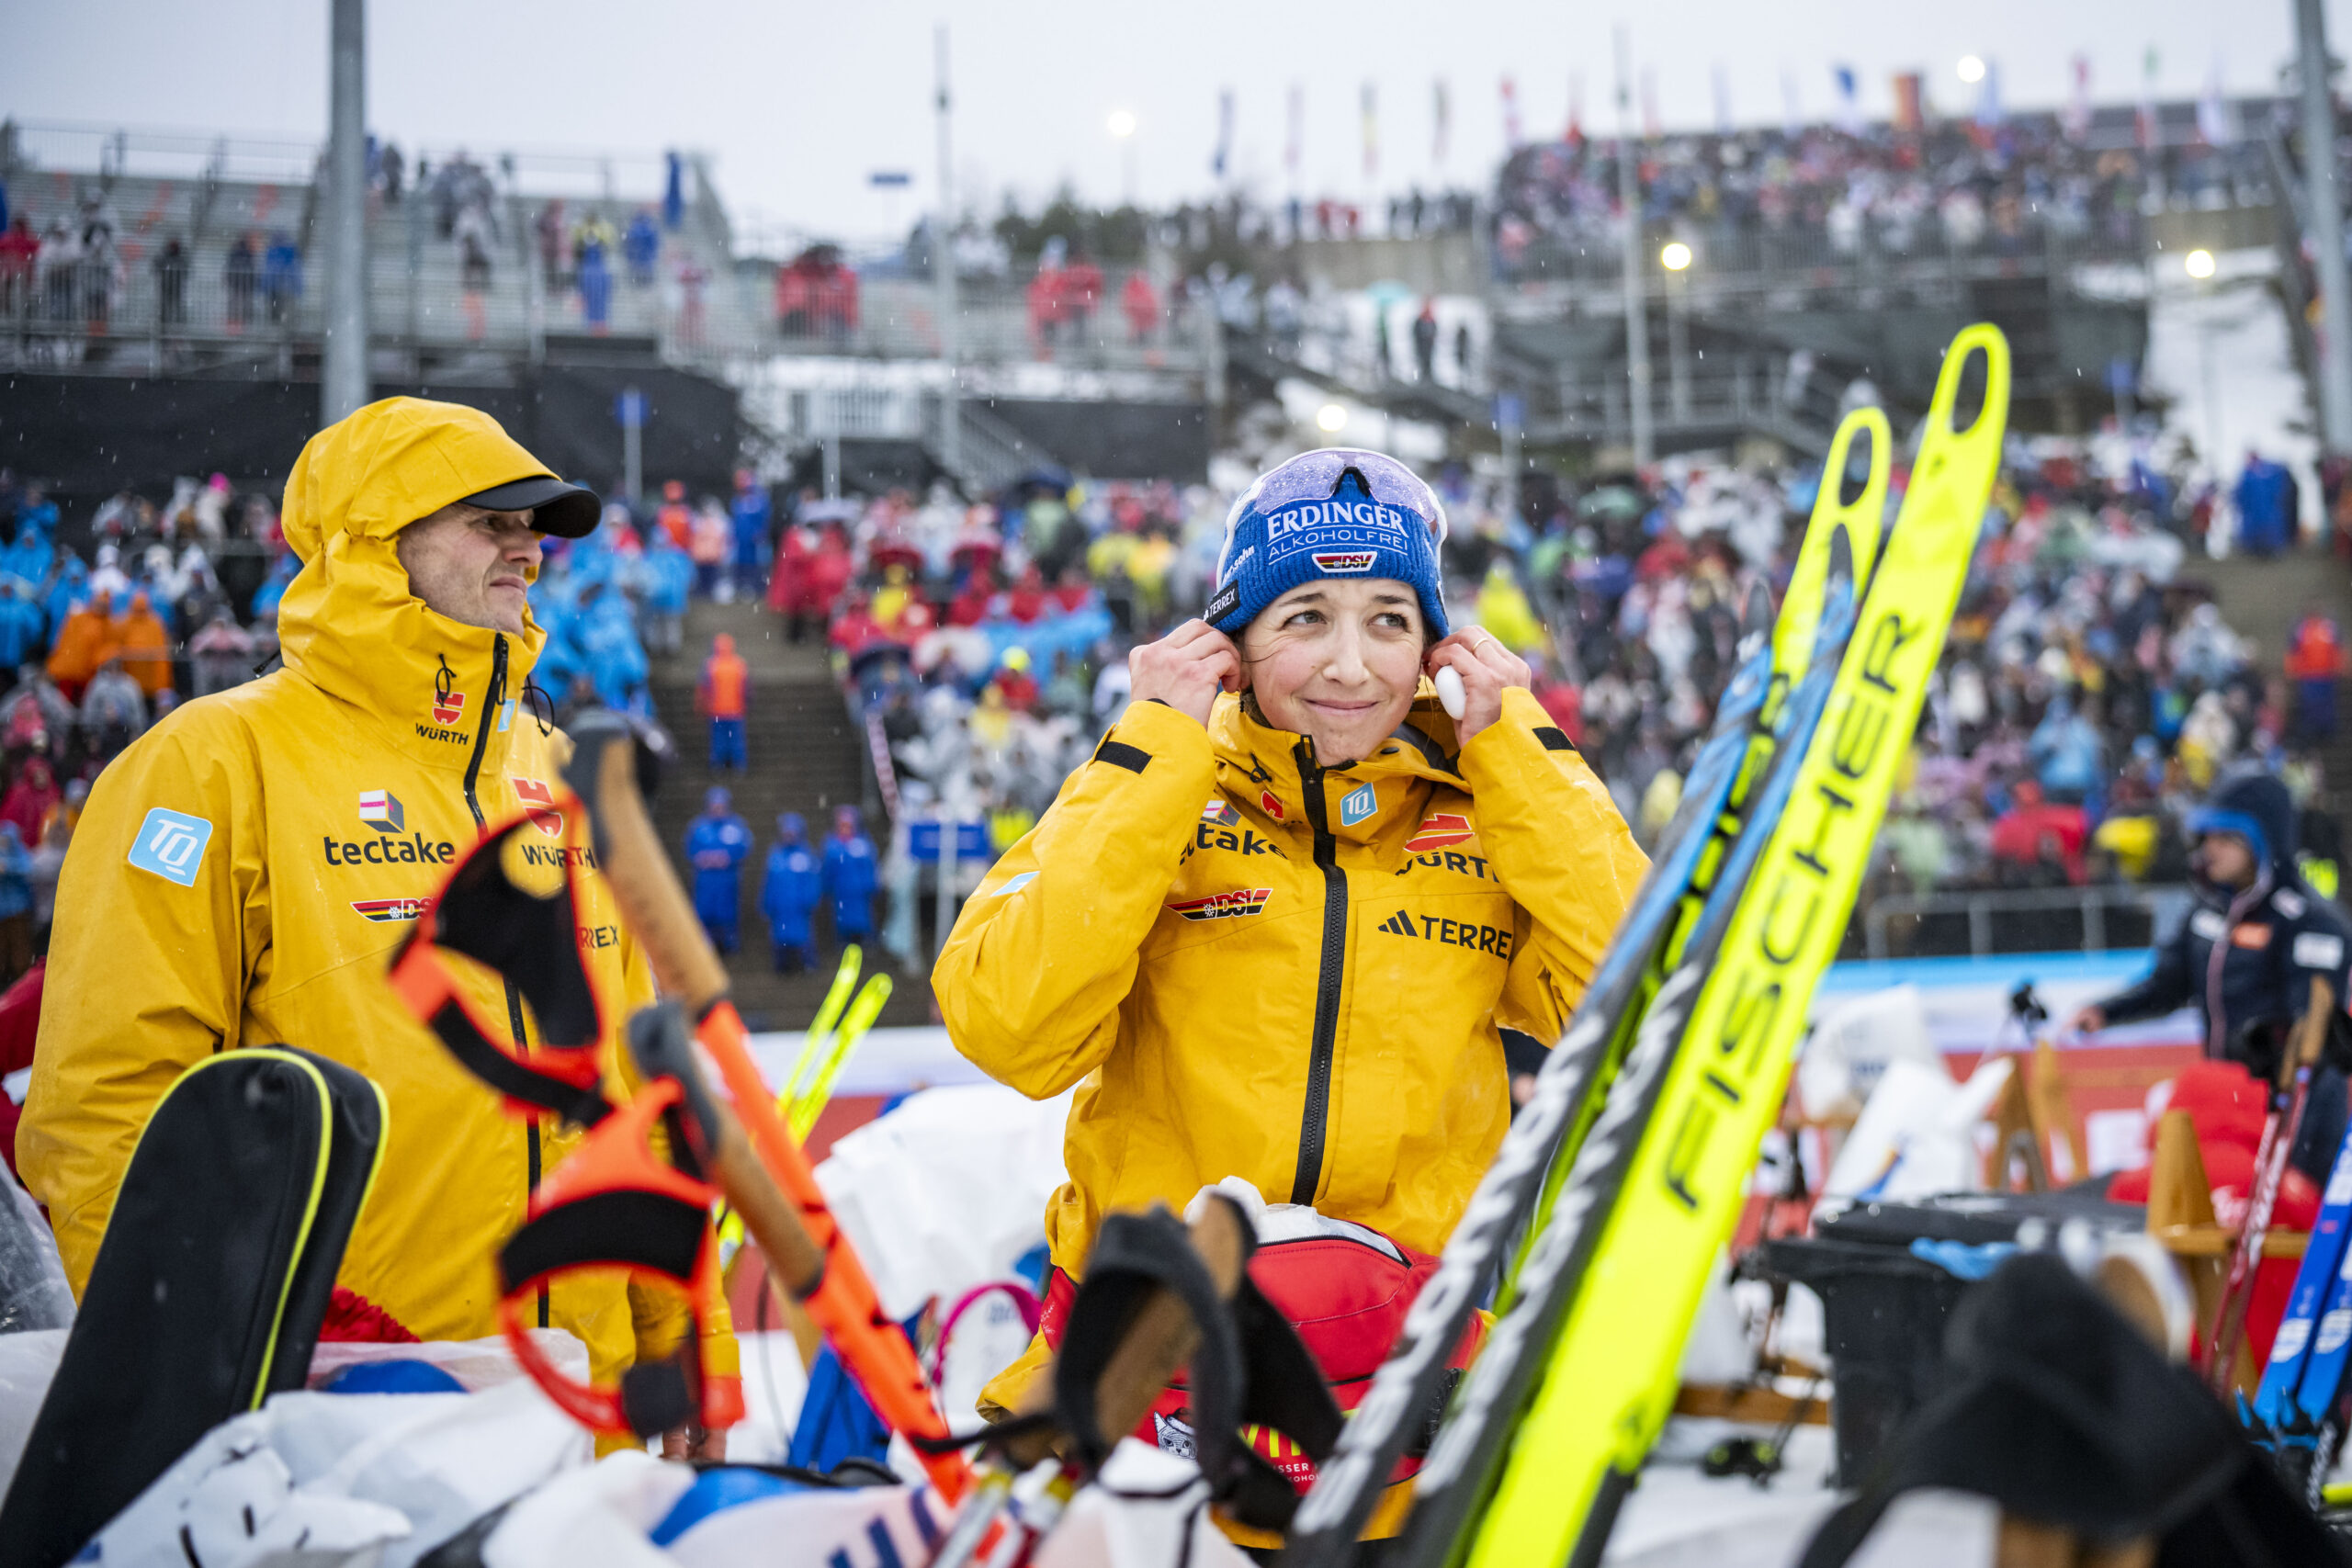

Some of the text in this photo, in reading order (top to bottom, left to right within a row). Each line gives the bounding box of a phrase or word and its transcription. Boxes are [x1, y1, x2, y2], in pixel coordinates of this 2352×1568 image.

[1267, 502, 1409, 544] ERDINGER
[1268, 529, 1408, 559] ALKOHOLFREI
[1344, 554, 1373, 570] DSV
[1209, 588, 1236, 617] TERREX
[415, 722, 469, 746] WÜRTH
[322, 832, 456, 866] tectake
[521, 844, 597, 870] WÜRTH
[1215, 887, 1273, 919] DSV
[1661, 612, 1922, 1211] FISCHER
[1419, 914, 1513, 963] TERRE
